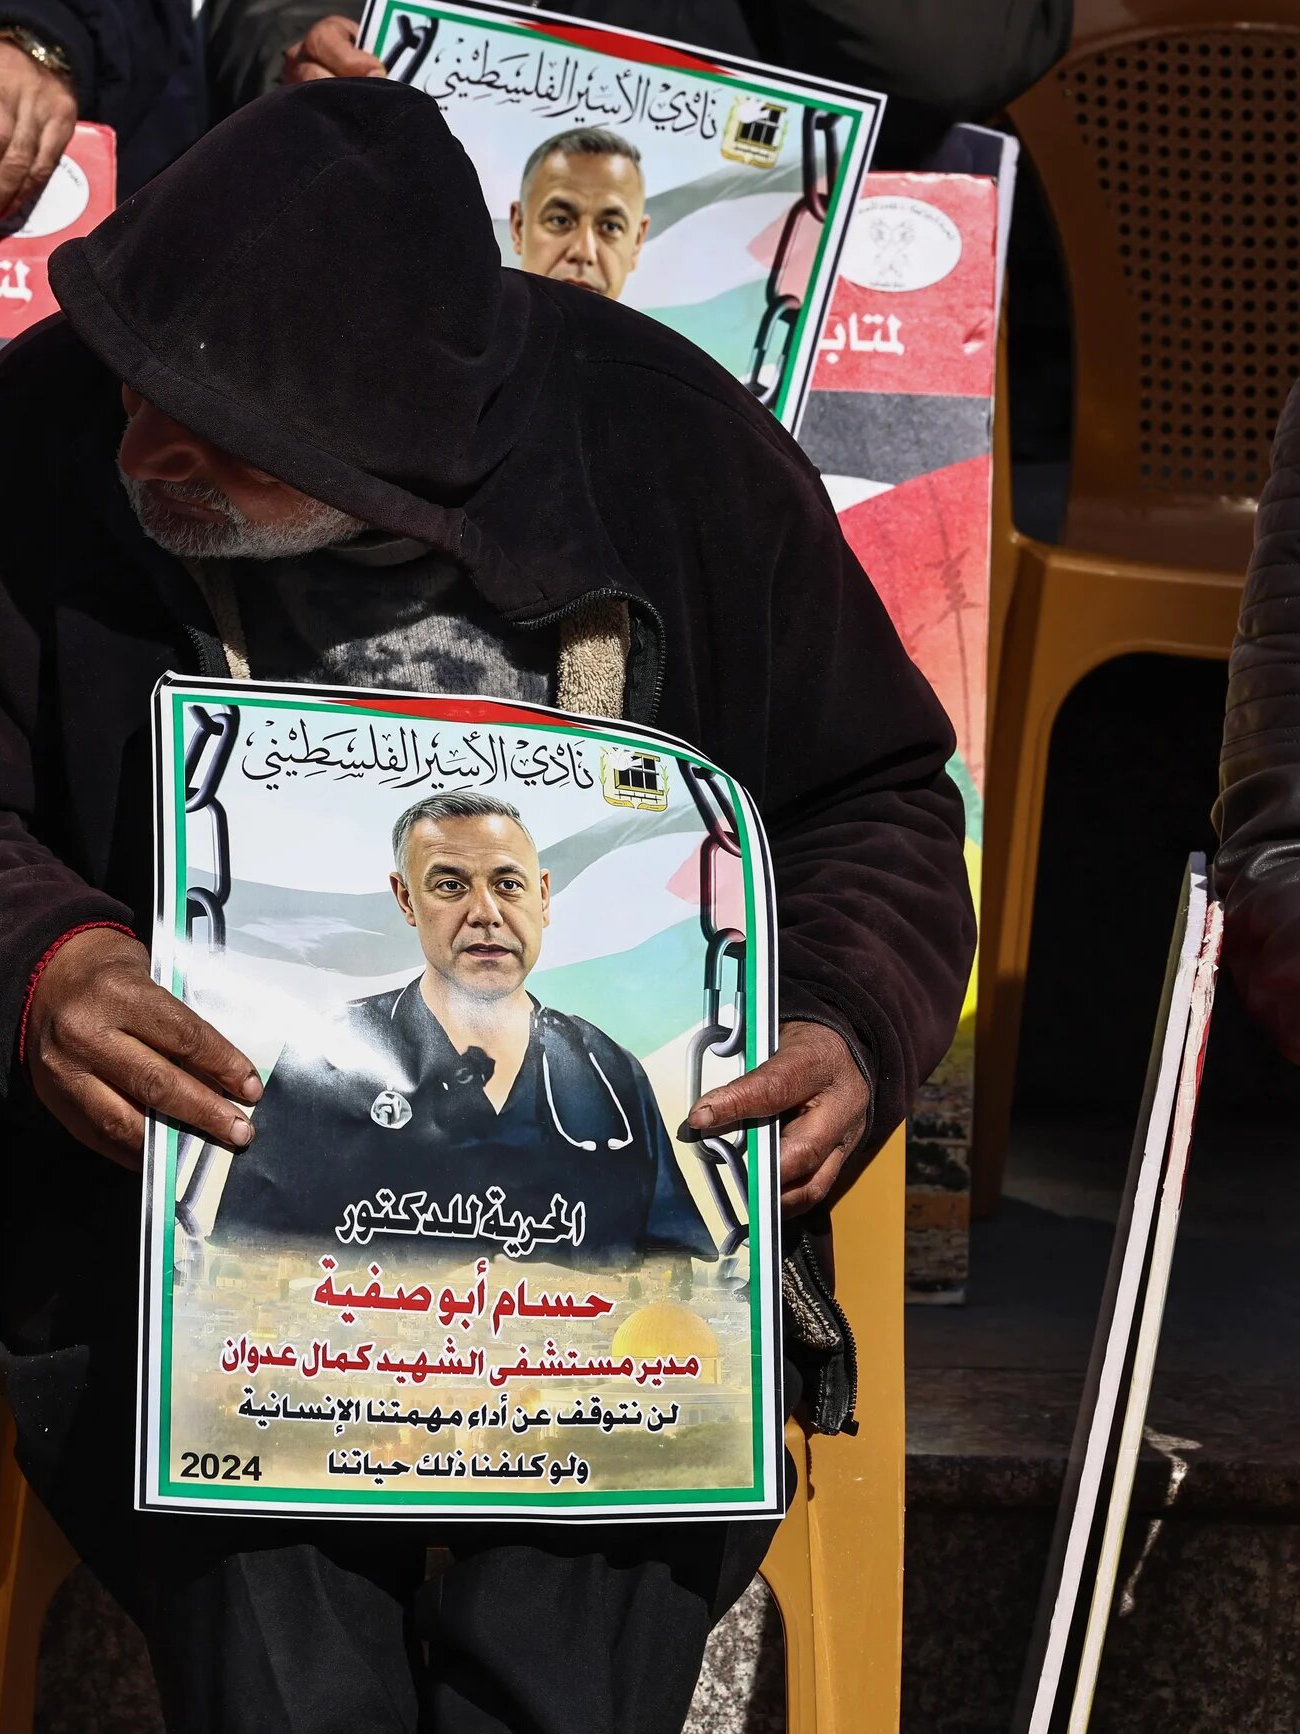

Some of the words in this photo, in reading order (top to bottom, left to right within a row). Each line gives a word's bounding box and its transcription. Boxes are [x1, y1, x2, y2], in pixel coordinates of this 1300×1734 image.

[335, 1188, 483, 1245] للدكتور
[478, 1186, 586, 1257] الحرية
[312, 1255, 433, 1326] صفية
[437, 1257, 489, 1330] أبو
[491, 1278, 616, 1337] حسام
[221, 1336, 297, 1374] عدوان
[301, 1341, 374, 1378] كمال
[376, 1337, 485, 1384] الشهيد
[489, 1339, 634, 1387] مستشفى
[635, 1355, 700, 1387] مدير
[238, 1387, 361, 1435] الإنسانية
[366, 1399, 463, 1434] مهمتنا
[467, 1393, 508, 1430] أداء
[511, 1406, 551, 1433] عن
[556, 1396, 643, 1433] نتوقف
[646, 1402, 679, 1432] لن
[180, 1451, 263, 1482] 2024
[326, 1449, 411, 1486] حياتنا
[415, 1449, 466, 1478] ذلك
[469, 1450, 546, 1480] كلفنا
[548, 1455, 590, 1486] ولو
